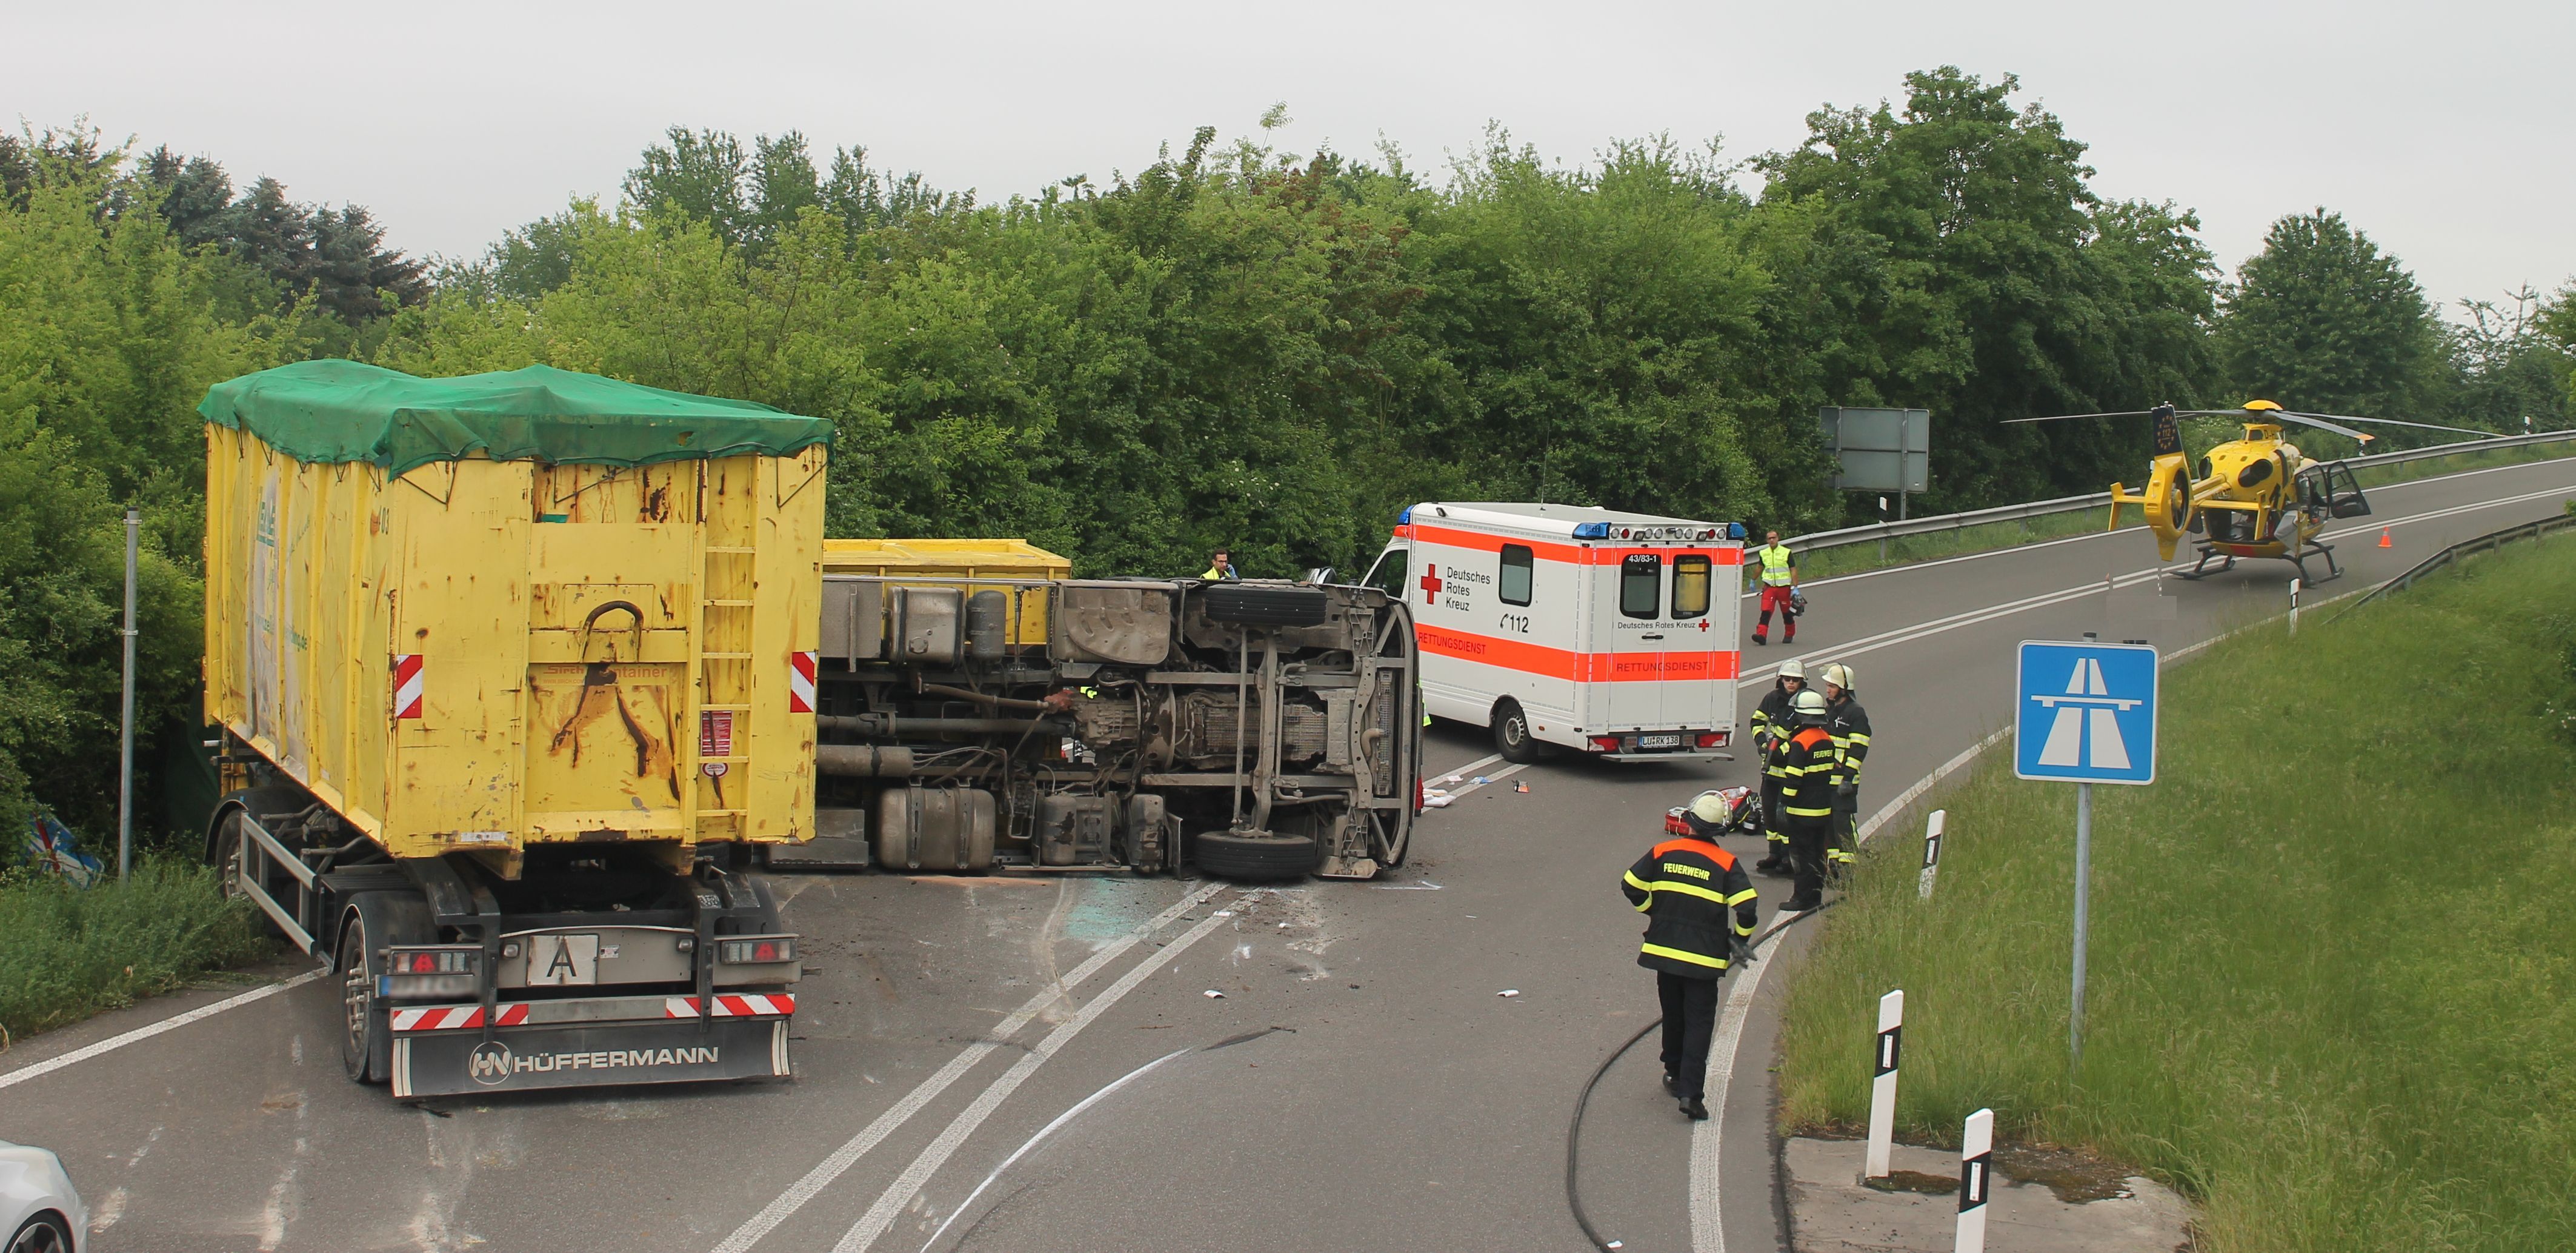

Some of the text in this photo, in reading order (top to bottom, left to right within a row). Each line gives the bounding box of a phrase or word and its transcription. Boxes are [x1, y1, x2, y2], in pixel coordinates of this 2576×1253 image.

[1447, 566, 1491, 584] Deutsches
[1446, 582, 1470, 596] Rotes
[1446, 596, 1469, 611] Kreuz
[1509, 615, 1529, 633] 112
[1419, 632, 1486, 655] RETTUNGSDIENST
[1616, 661, 1708, 672] RETTUNGSDIENST
[1663, 863, 1711, 881] FEUERWEHR
[547, 937, 577, 977] A
[514, 1046, 719, 1073] HÜFFERMANN
